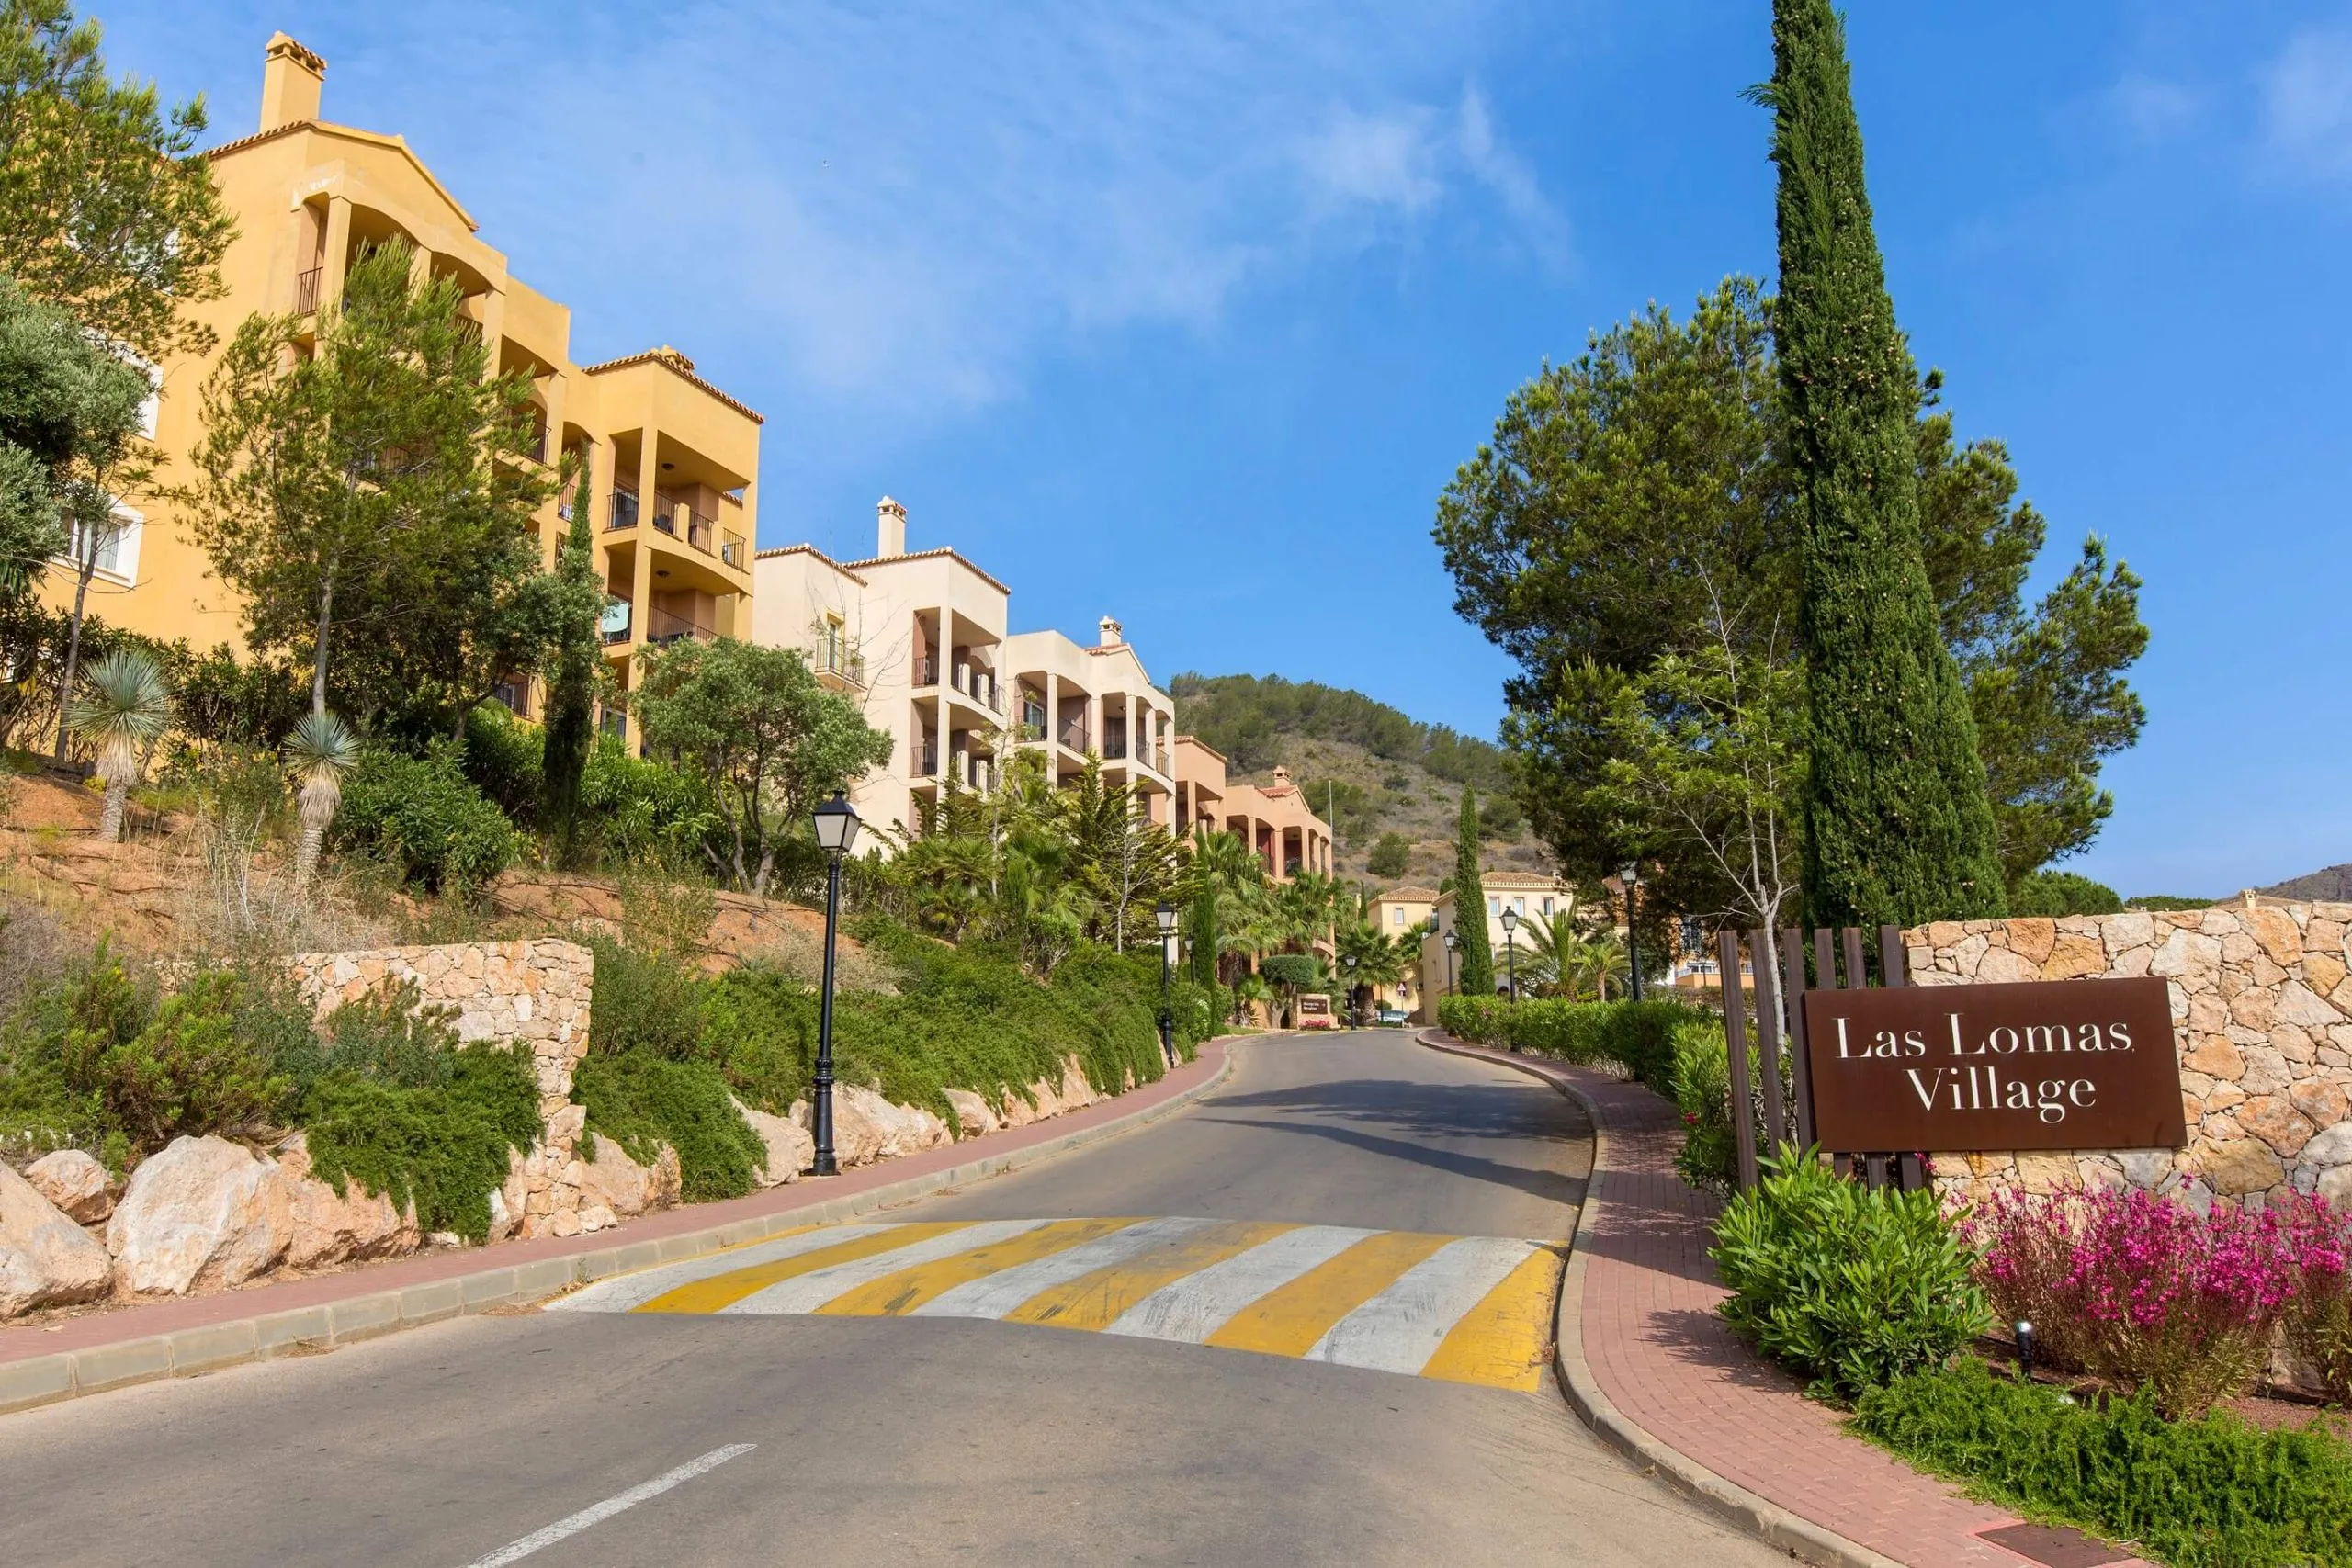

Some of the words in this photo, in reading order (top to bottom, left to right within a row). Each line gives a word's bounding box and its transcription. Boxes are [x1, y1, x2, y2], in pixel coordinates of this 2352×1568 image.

[1831, 1016, 1926, 1059] Las
[1945, 1012, 2132, 1055] Lomas
[1904, 1066, 2097, 1124] Village
